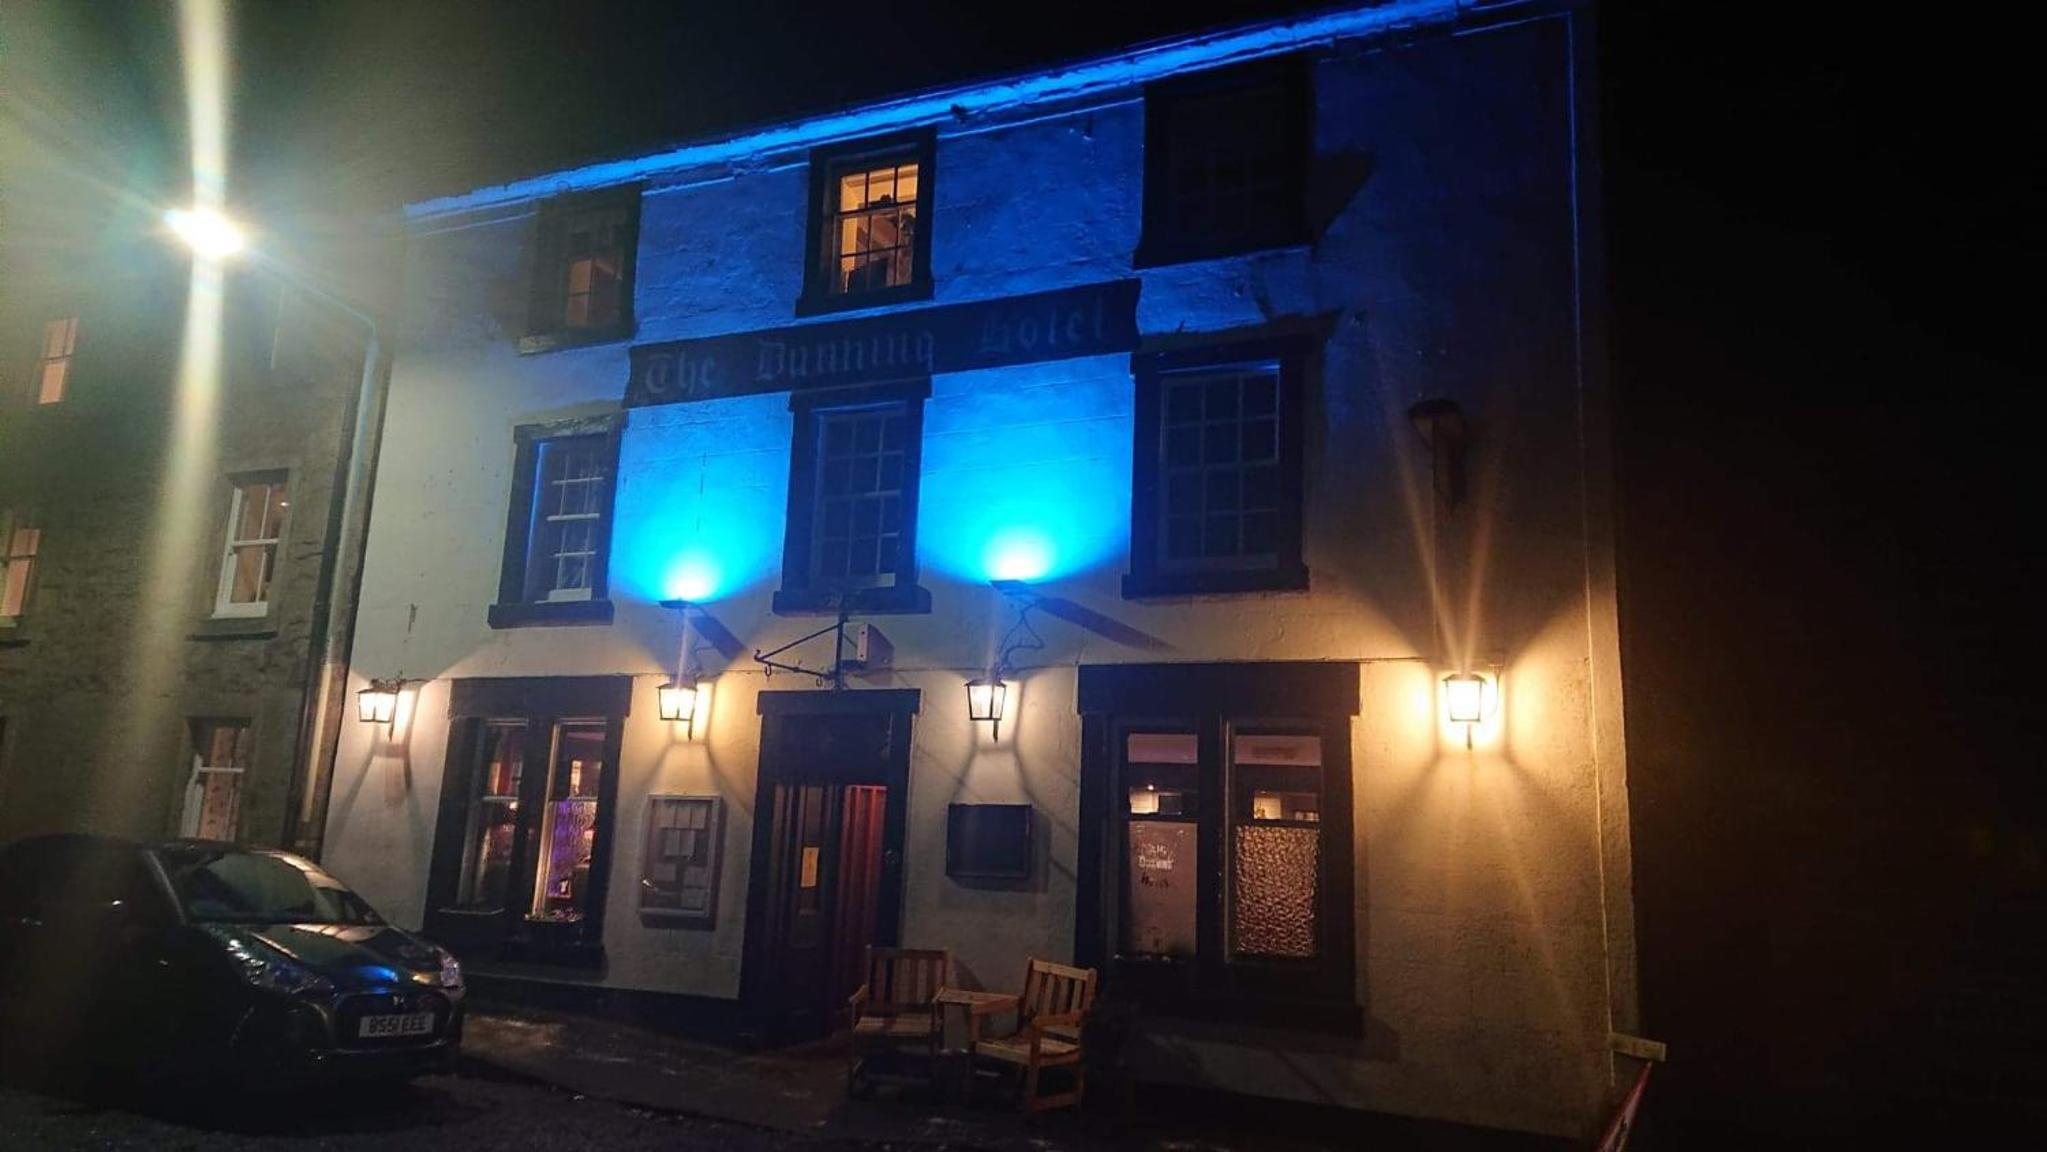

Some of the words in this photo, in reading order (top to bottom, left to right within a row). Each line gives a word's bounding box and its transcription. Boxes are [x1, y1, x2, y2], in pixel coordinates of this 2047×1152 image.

[647, 351, 717, 393] The
[754, 329, 935, 381] Dunning
[977, 290, 1106, 352] Hotel
